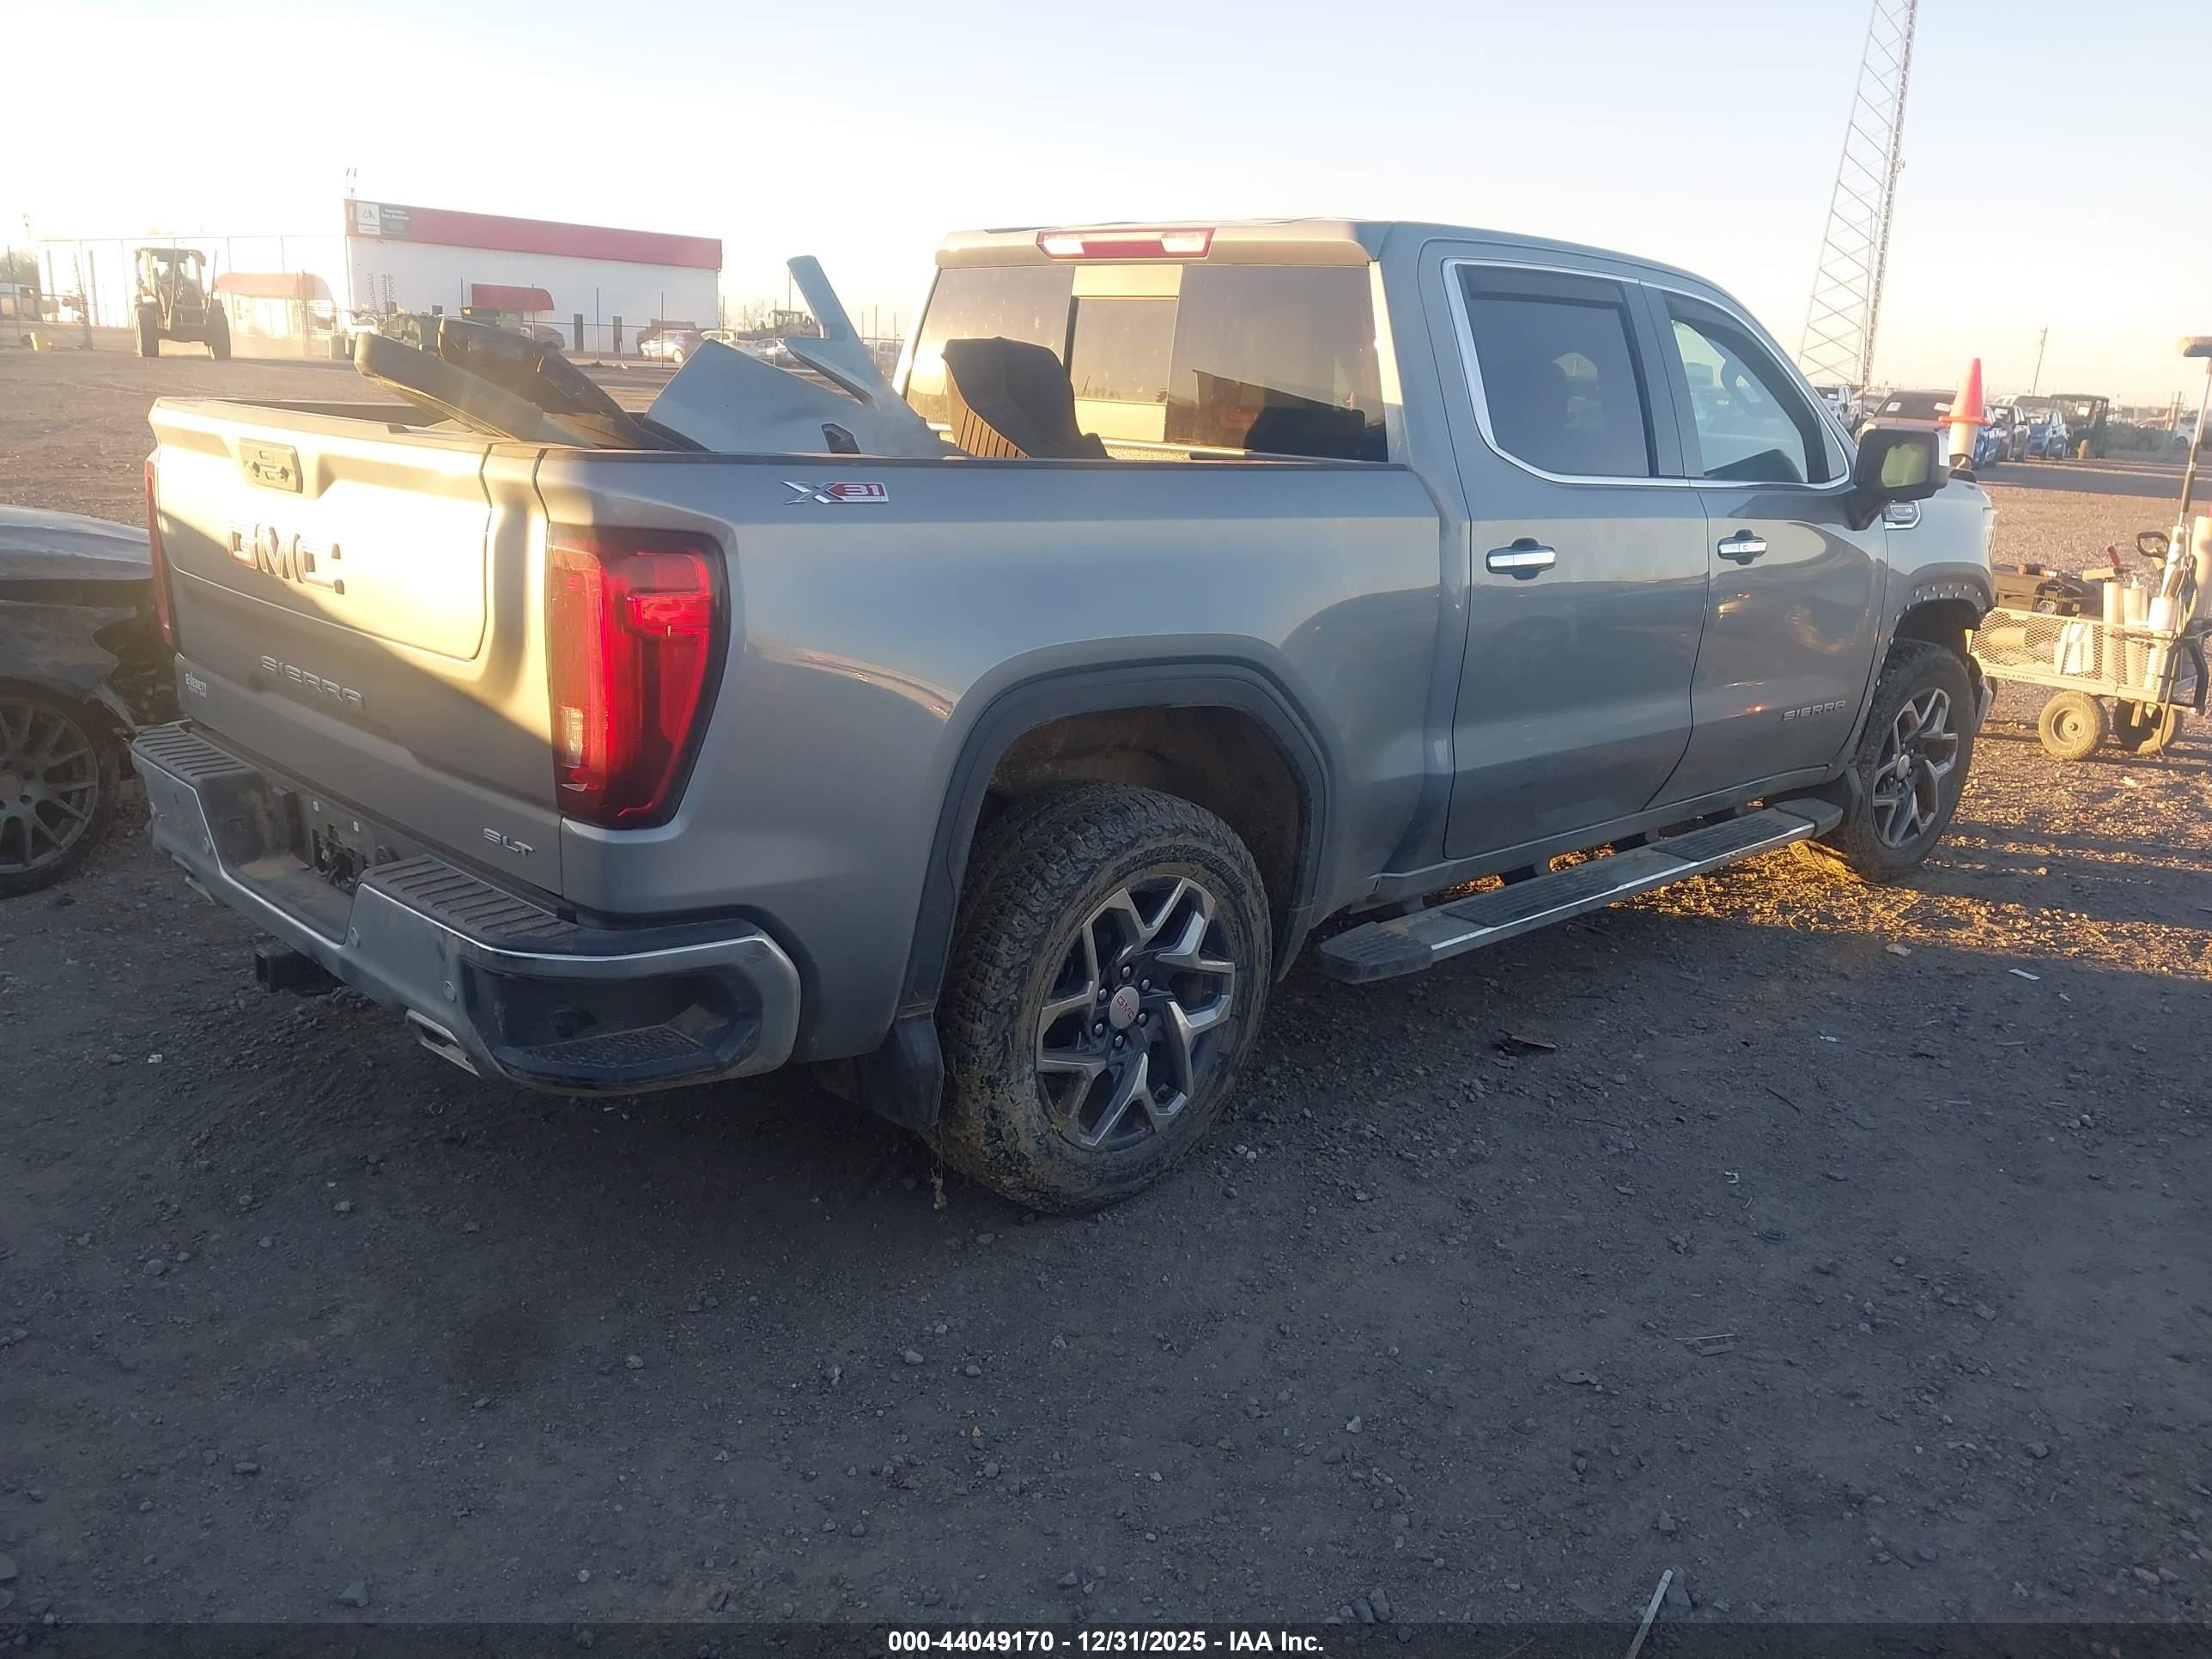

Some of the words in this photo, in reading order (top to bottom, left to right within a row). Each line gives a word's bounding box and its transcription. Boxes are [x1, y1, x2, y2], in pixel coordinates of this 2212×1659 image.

[227, 521, 344, 594] GMC
[261, 655, 364, 709] SIERRA
[1783, 700, 1846, 722] SIERRA
[483, 828, 534, 858] SLT
[1116, 995, 1134, 1020] GMC
